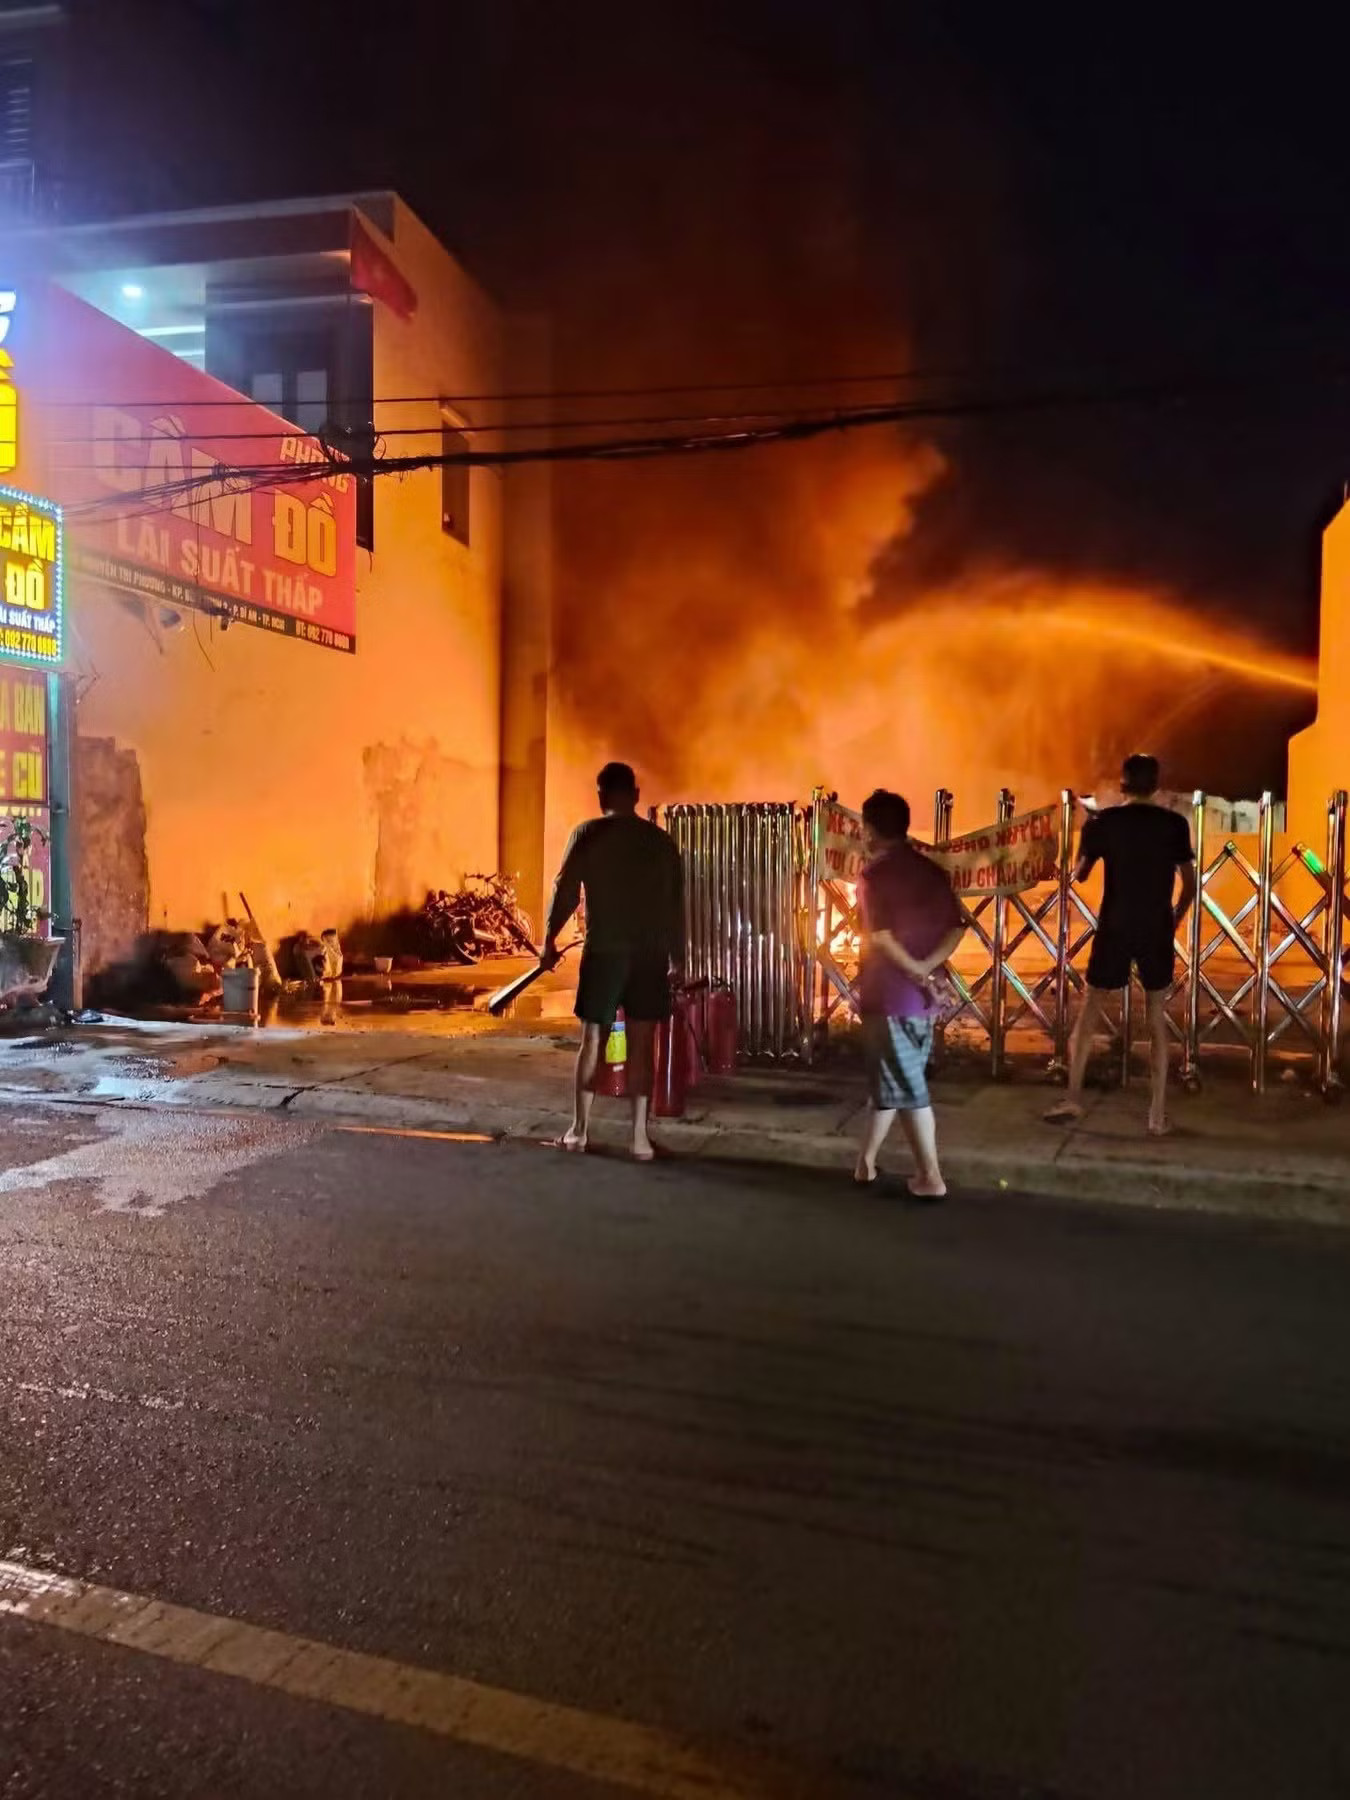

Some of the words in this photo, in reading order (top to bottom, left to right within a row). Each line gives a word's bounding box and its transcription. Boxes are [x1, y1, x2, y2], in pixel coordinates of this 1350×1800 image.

[92, 404, 252, 545] CẦM
[272, 491, 337, 577] ĐỒ
[4, 558, 45, 610] ĐỒ
[181, 538, 255, 594] SUẤT
[261, 568, 324, 616] THẤP
[9, 608, 32, 629] SUẤT
[33, 615, 56, 634] THẤP
